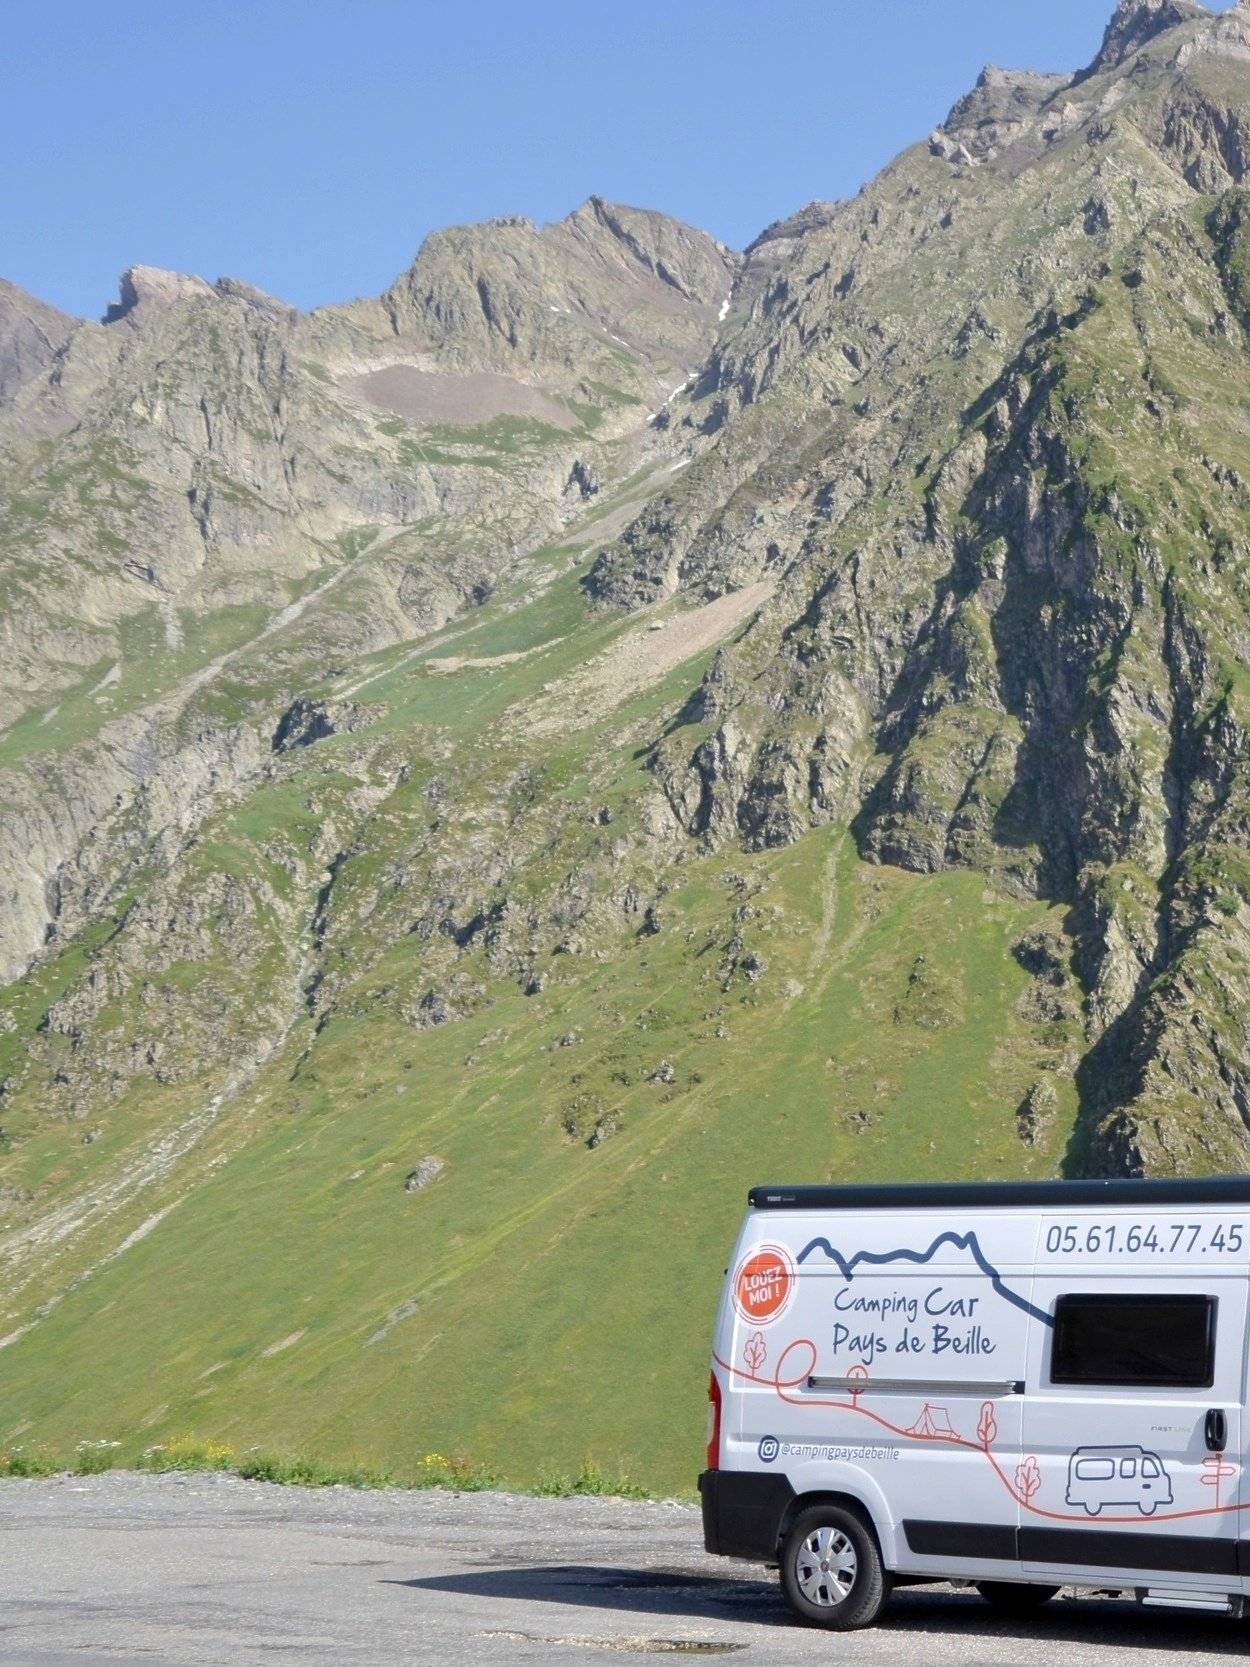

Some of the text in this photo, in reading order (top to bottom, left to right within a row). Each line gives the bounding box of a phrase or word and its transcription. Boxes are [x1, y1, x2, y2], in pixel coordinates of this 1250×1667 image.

[1046, 1224, 1243, 1253] 05.61.64.77.45
[744, 1265, 783, 1292] LOUEZ
[749, 1285, 773, 1306] MOI
[834, 1287, 979, 1323] Camping Car
[833, 1322, 997, 1365] Pays de Beille
[781, 1443, 900, 1461] @campingpaysdebeille
